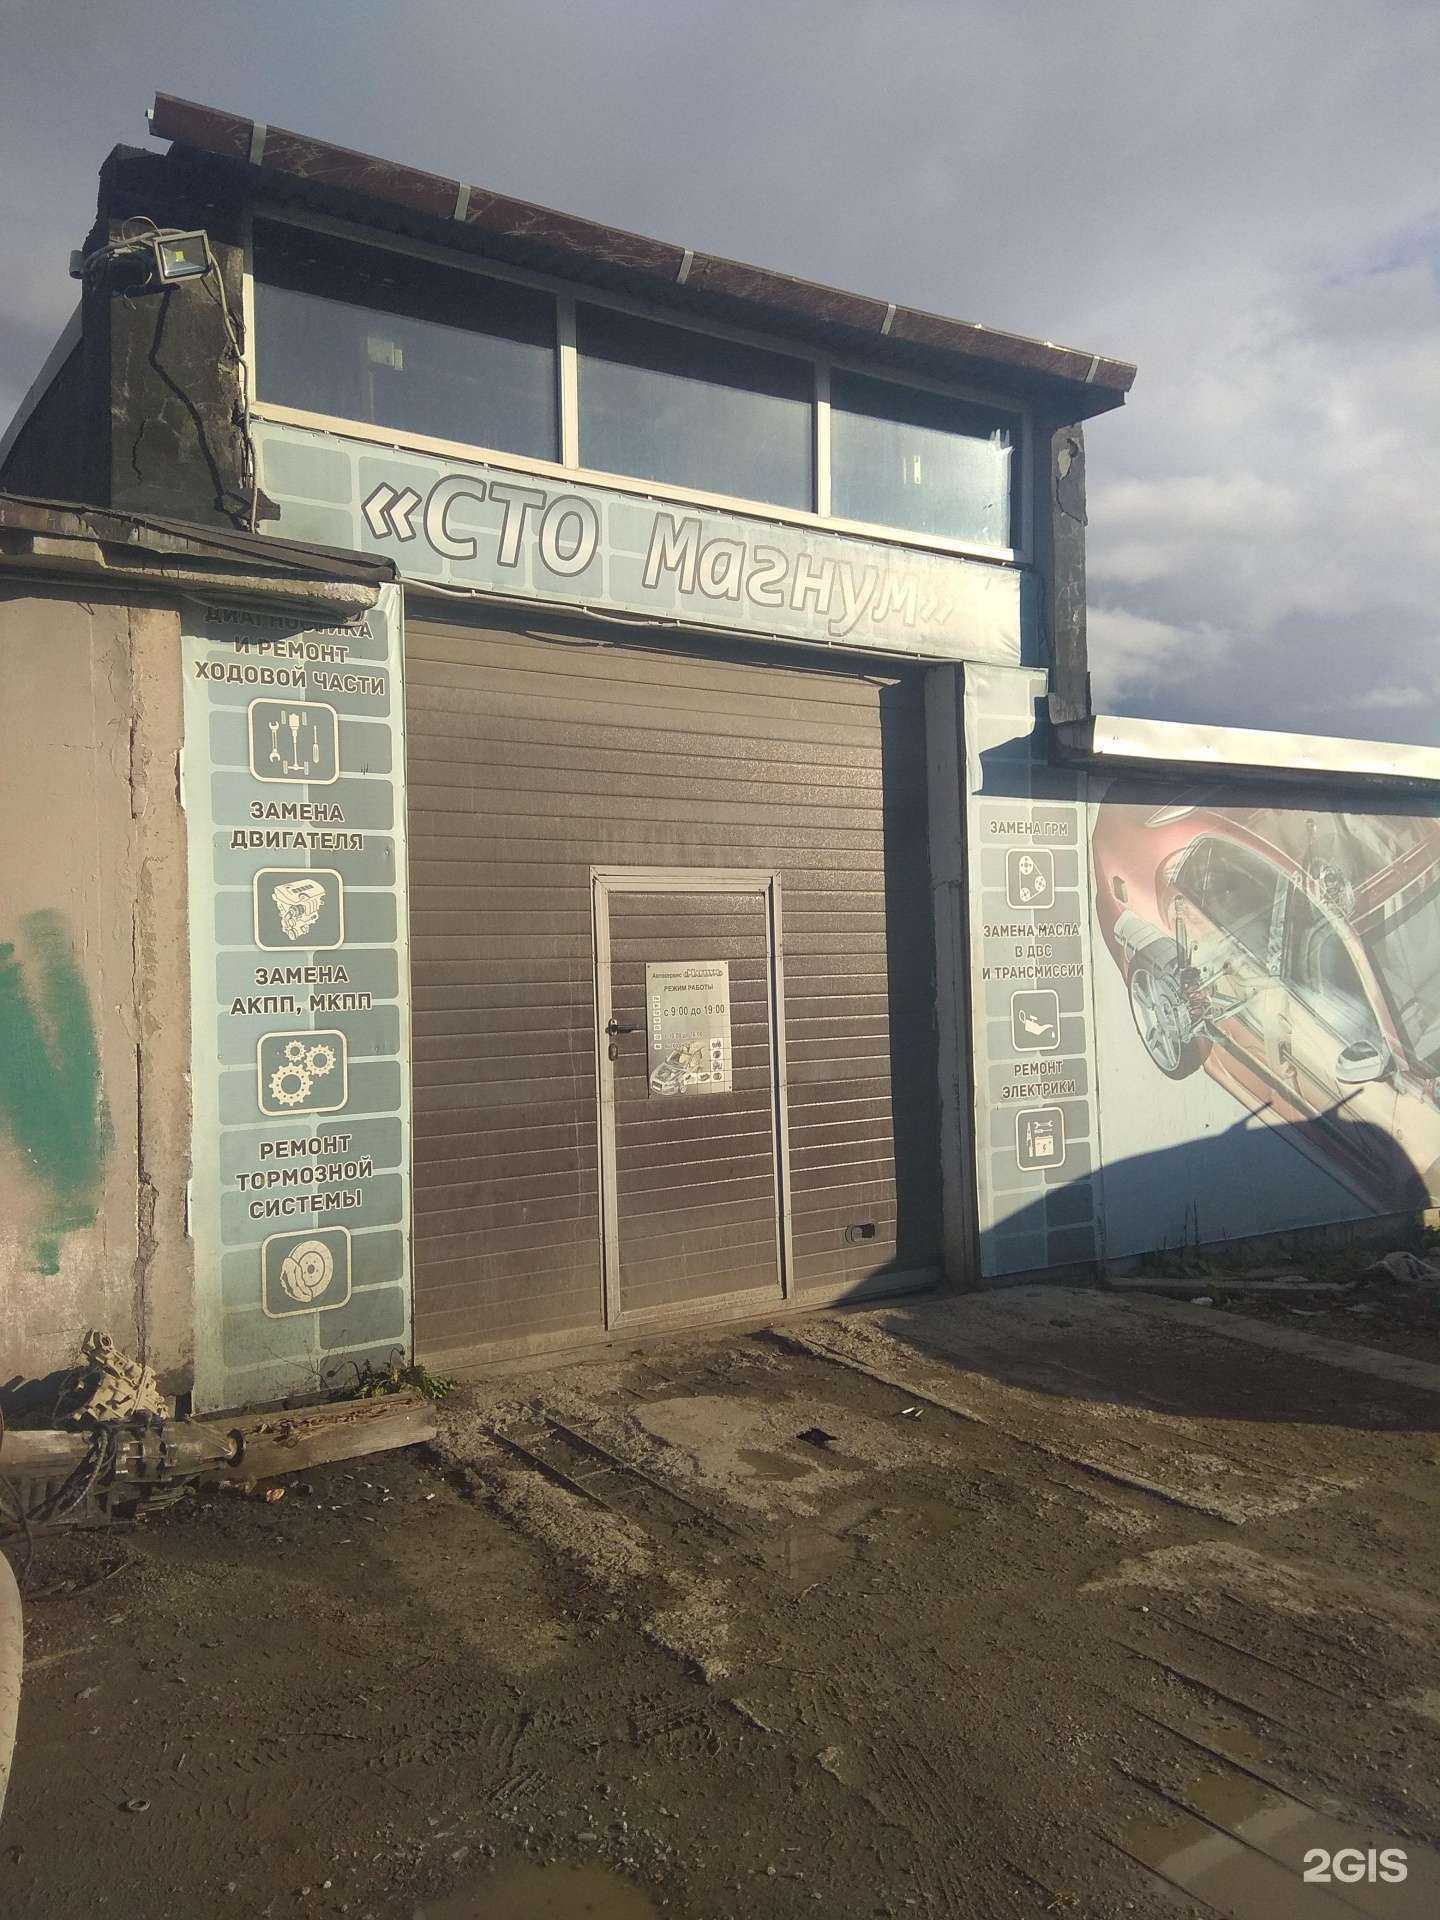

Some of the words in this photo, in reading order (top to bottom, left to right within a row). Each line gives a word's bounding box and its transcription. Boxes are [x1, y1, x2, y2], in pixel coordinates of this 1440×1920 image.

[361, 474, 600, 577] «СТО
[234, 635, 250, 654] И
[258, 639, 349, 663] РЕМОНТ
[194, 661, 306, 688] ХОДОВОЙ
[313, 672, 385, 695] ЧАСТИ
[250, 801, 345, 822] ЗАМЕНА
[990, 821, 1040, 835] ЗАМЕНА
[1044, 823, 1068, 836] ГРМ
[230, 830, 363, 850] ДВИГАТЕЛЯ
[983, 925, 1035, 938] ЗАМЕНА
[1038, 924, 1080, 937] МАСЛА
[1015, 945, 1023, 958] В
[1027, 945, 1052, 958] ДВС
[255, 966, 348, 985] ЗАМЕНА
[982, 967, 991, 980] И
[995, 965, 1085, 980] ТРАНСМИССИИ
[230, 996, 302, 1015] АКПП,
[310, 993, 371, 1012] МКПП
[691, 1007, 701, 1016] до
[1014, 1061, 1063, 1076] РЕМОНТ
[1002, 1081, 1075, 1098] ЭЛЕКТРИКИ
[260, 1134, 352, 1160] РЕМОНТ
[235, 1156, 372, 1192] ТОРМОЗНОЙ
[249, 1190, 362, 1219] СИСТЕМЫ
